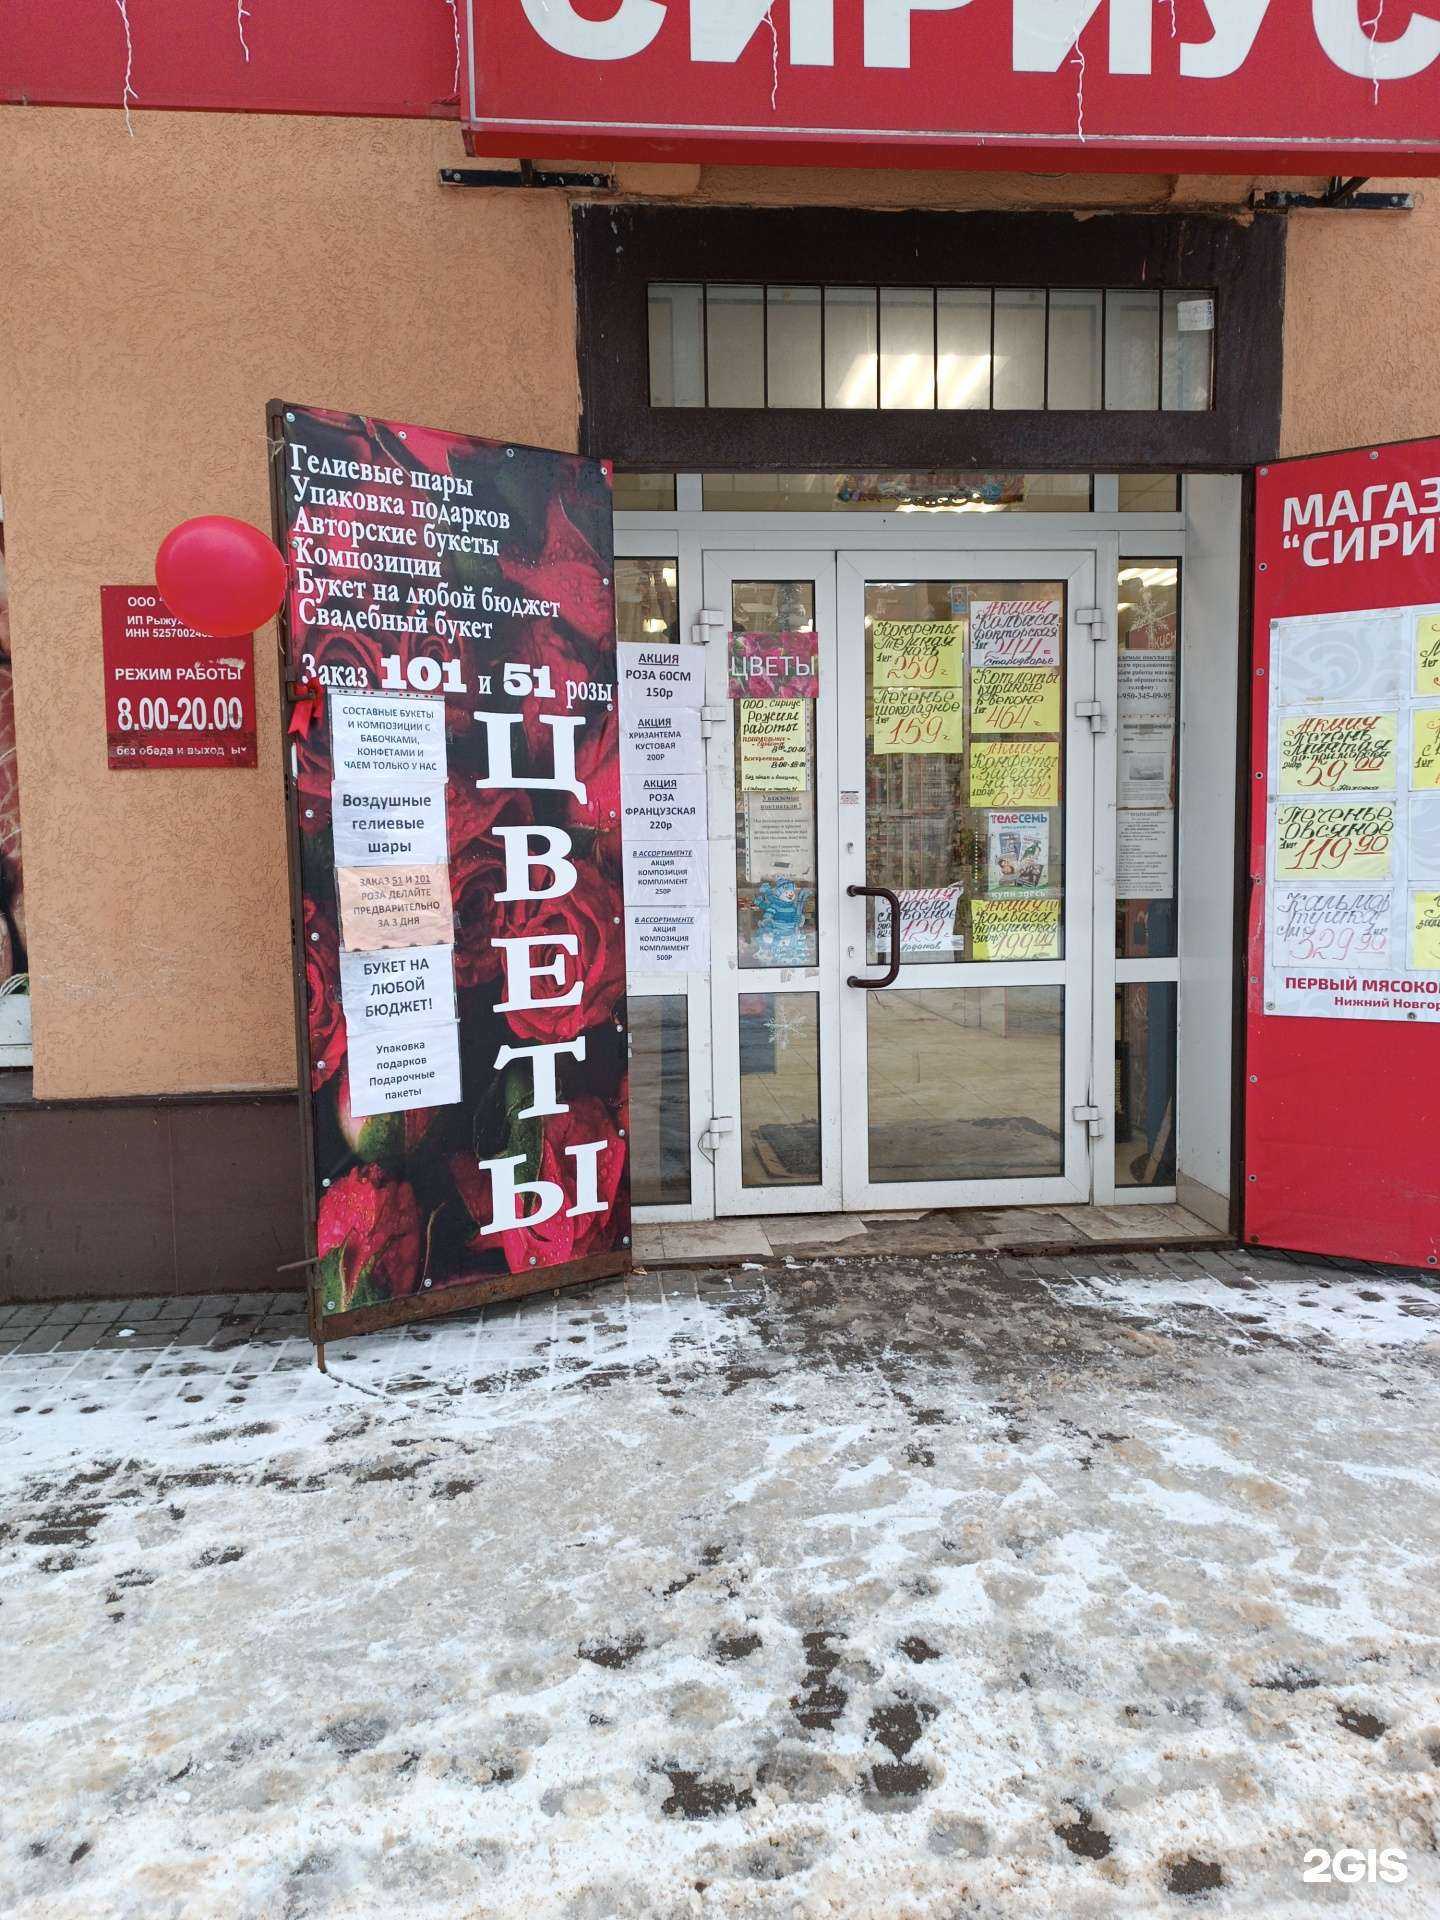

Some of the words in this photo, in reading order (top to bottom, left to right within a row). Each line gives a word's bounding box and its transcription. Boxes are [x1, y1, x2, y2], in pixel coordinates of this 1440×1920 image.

[290, 443, 402, 485] Гелиевые
[410, 471, 473, 501] шары
[291, 474, 404, 516] Упаковка
[411, 499, 510, 532] подарков
[1283, 477, 1440, 532] МАГАЗ
[293, 507, 417, 547] Авторские
[423, 526, 499, 557] букеты
[1283, 518, 1440, 567] “СИРИ
[296, 536, 441, 578] Композиции
[297, 568, 366, 603] Букет
[373, 582, 399, 602] на
[406, 581, 476, 611] любой
[481, 588, 560, 618] бюджет
[128, 597, 155, 607] ООО
[127, 616, 143, 625] ИП
[299, 598, 428, 635] Свадебный
[434, 611, 493, 643] букет
[126, 629, 149, 637] ИНН
[638, 653, 679, 666] АКЦИЯ
[115, 668, 172, 680] РЕЖИМ
[176, 668, 241, 680] РАБОТЫ
[731, 656, 815, 680] ЦВЕТЫ
[301, 653, 368, 688] Заказ
[380, 654, 467, 693] 101
[478, 674, 492, 694] и
[503, 662, 556, 698] 51
[566, 679, 612, 708] розы
[626, 670, 656, 680] РОЗА
[659, 670, 691, 681] 60СМ
[646, 687, 673, 700] 150р
[117, 697, 243, 731] 8.00-20.00
[343, 706, 398, 717] СОСТАВНЫЕ
[400, 709, 434, 719] БУКЕТЫ
[357, 721, 423, 732] КОМПОЗИЦИИ
[638, 718, 672, 728] АКЦИЯ
[360, 735, 420, 745] БАБОЧКАМИ,
[629, 731, 681, 739] ХРИЗАНТЕМА
[116, 746, 135, 755] без
[139, 746, 174, 757] обеда
[177, 747, 184, 755] и
[187, 747, 247, 756] выходых
[357, 748, 415, 757] КОНФЕТАМИ
[417, 749, 423, 757] И
[635, 742, 676, 750] КУСТОВАЯ
[344, 761, 371, 770] ЧАЕМ
[372, 761, 410, 770] ТОЛЬКО
[411, 762, 418, 771] У
[420, 762, 437, 771] НАС
[643, 779, 677, 789] АКЦИЯ
[343, 794, 432, 810] Воздушные
[649, 793, 674, 802] РОЗА
[625, 806, 696, 816] ФРАНЦУЗСКАЯ
[352, 818, 425, 830] гелиевые
[650, 820, 672, 831] 220р
[368, 841, 411, 856] шары
[638, 869, 688, 877] КОМПОЗИЦИЯ
[360, 877, 390, 887] ЗАКАЗ
[392, 876, 403, 886] 51
[406, 875, 413, 884] И
[415, 874, 431, 885] 101
[361, 890, 387, 900] РОЗА
[389, 887, 431, 899] ДЕЛАЙТЕ
[353, 901, 440, 916] ПРЕДВАРИТЕЛЬНО
[378, 919, 390, 928] ЗА
[399, 917, 419, 927] ДНЯ
[640, 916, 695, 924] АССОРТИМЕНТЕ
[364, 961, 406, 975] БУКЕТ
[410, 958, 429, 970] НА
[474, 711, 609, 1236] ЦВЕТЫ
[371, 977, 425, 996] ЛЮБОЙ
[1285, 976, 1357, 991] ПЕРВЫЙ
[1362, 981, 1440, 994] МЯСОКО
[366, 998, 433, 1018] БЮДЖЕТ!
[1335, 997, 1389, 1008] Нижний
[376, 1041, 425, 1054] Упаковка
[376, 1056, 427, 1071] подарков
[369, 1070, 435, 1088] Подарочные
[385, 1087, 422, 1100] пакеты
